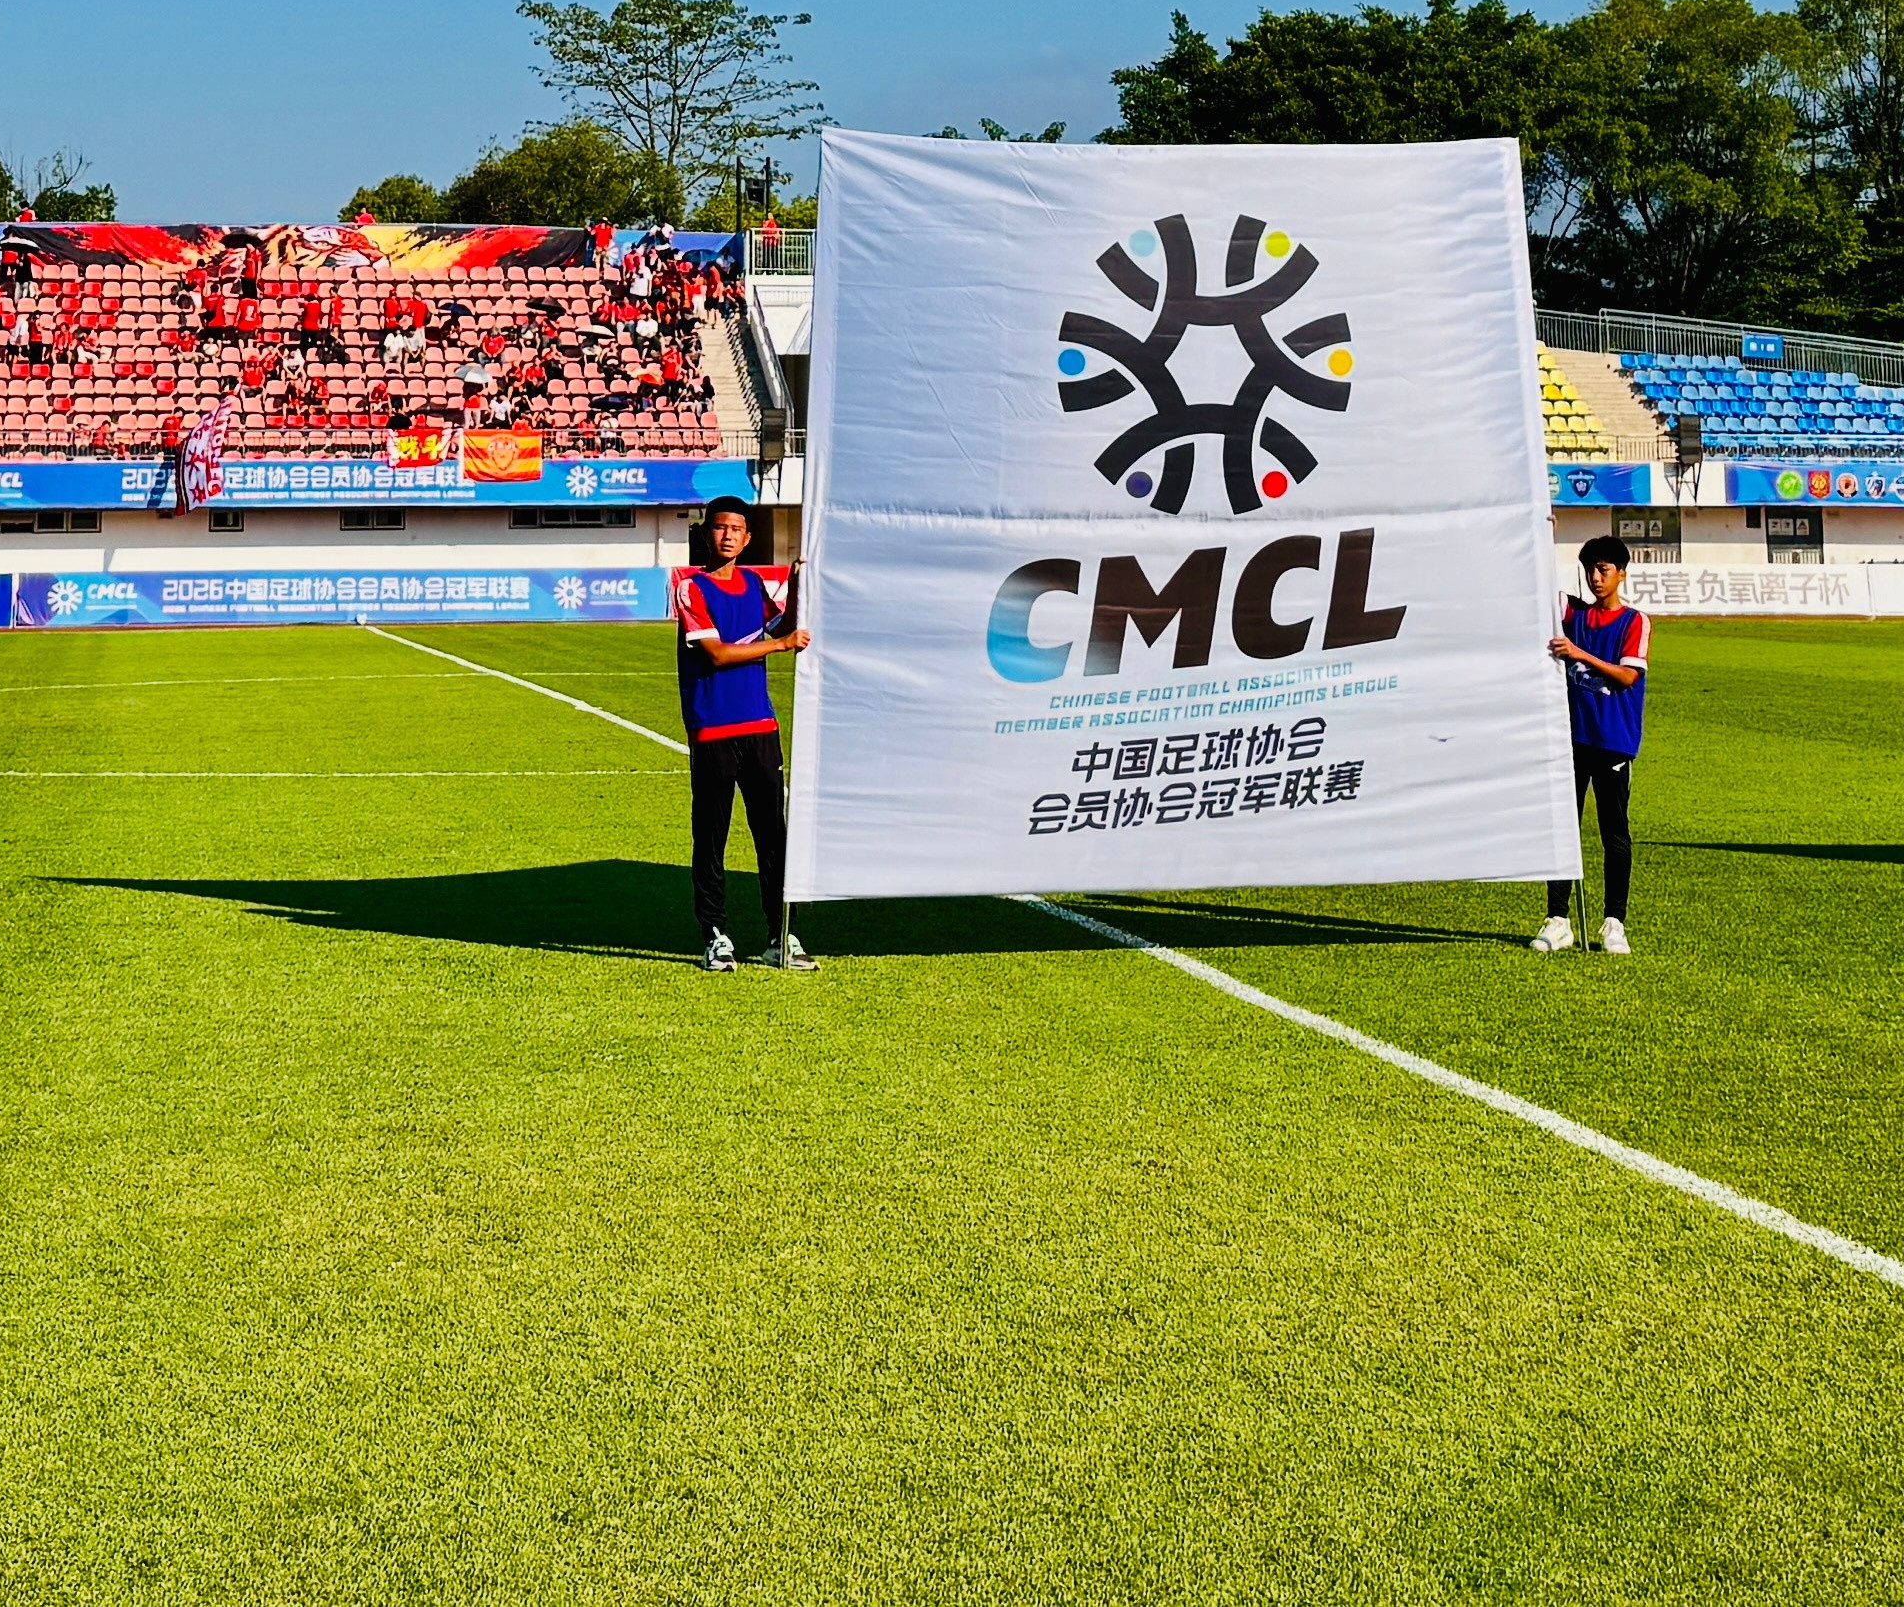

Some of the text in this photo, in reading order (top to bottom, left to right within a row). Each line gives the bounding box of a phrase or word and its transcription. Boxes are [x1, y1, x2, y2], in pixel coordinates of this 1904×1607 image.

[600, 468, 648, 485] CMCL
[86, 581, 138, 600] CMCL
[589, 579, 639, 596] CMCL
[985, 526, 1408, 685] CMCL
[1619, 569, 1851, 606] 克营 负氧离子杯
[994, 674, 1399, 734] MEMBER ASSOCIATION CHAMPIONS LEAGUE
[1049, 661, 1354, 710] CHINESE FOOTBALL ASSOCIATION
[1071, 715, 1328, 783] 中国足球协会
[1027, 759, 1366, 835] 会员协会冠军联赛
